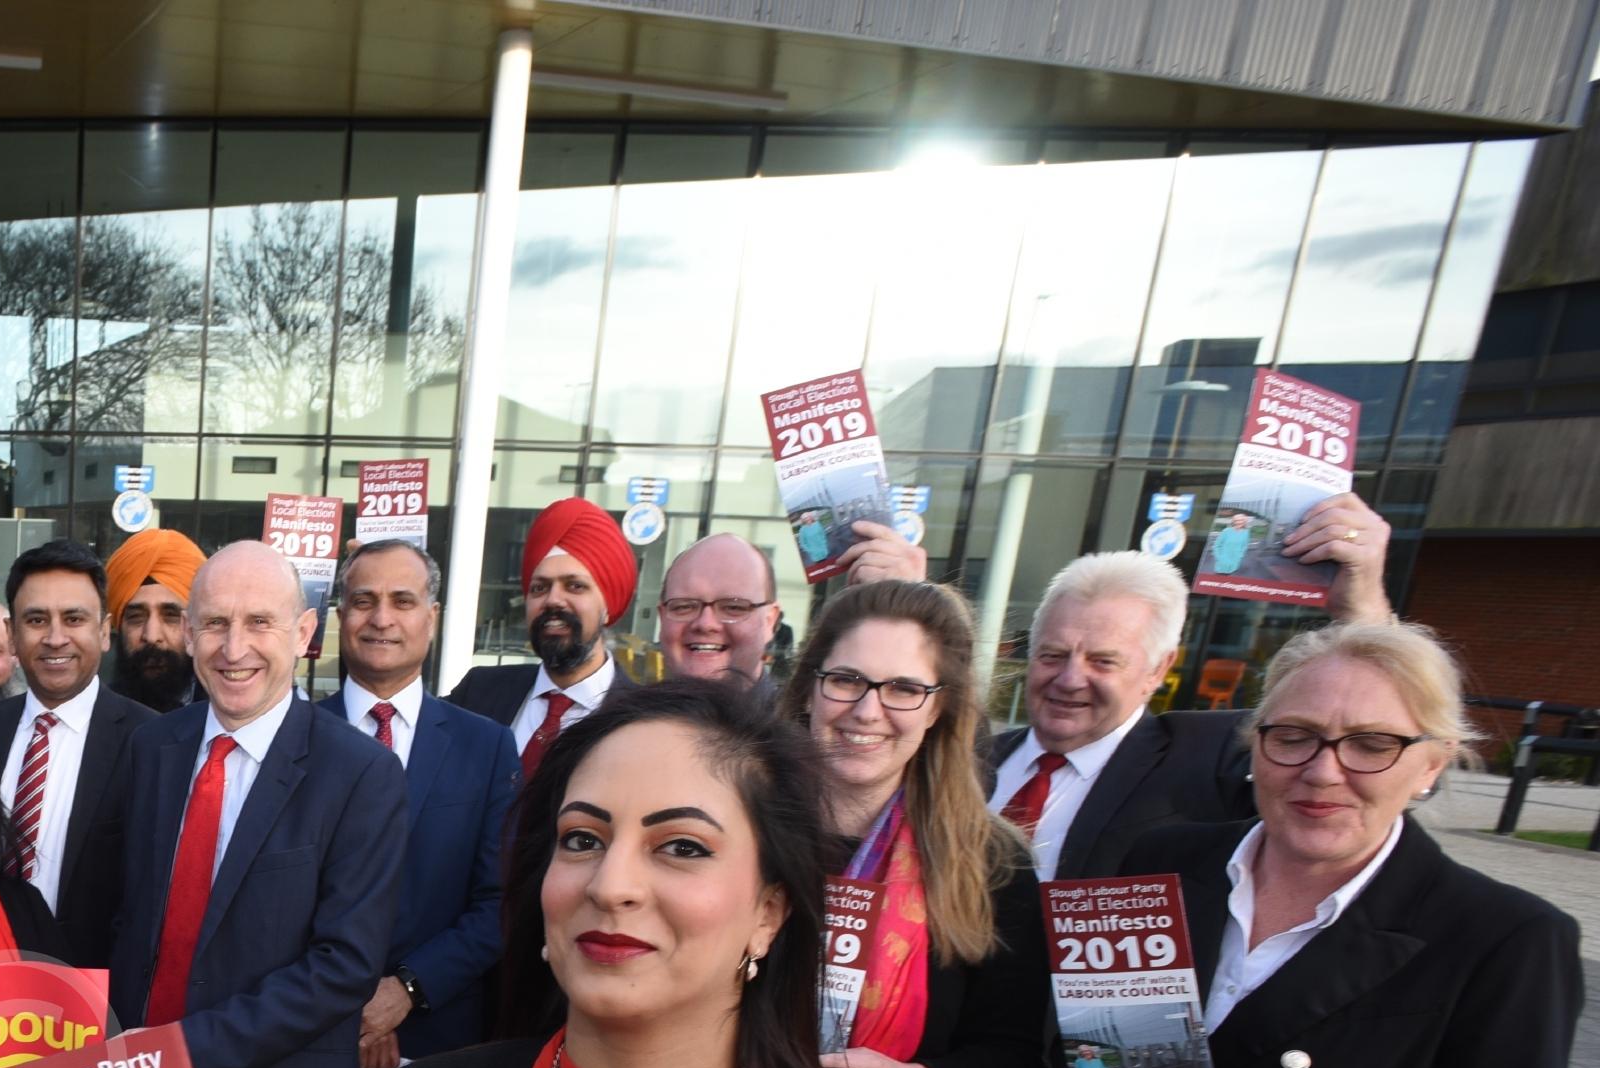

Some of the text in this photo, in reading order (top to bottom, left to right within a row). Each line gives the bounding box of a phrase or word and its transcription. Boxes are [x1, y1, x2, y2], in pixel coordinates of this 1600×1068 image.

[771, 383, 858, 414] Local Election
[774, 397, 861, 429] Manifesto
[1259, 399, 1350, 438] Manifesto
[777, 412, 867, 457] 2019
[1251, 416, 1348, 465] 2019
[363, 481, 423, 493] Manifesto
[362, 493, 422, 516] 2019
[270, 517, 335, 532] Manifesto
[269, 531, 333, 557] 2019
[846, 886, 876, 900] Party
[1049, 883, 1167, 899] Slough Labour Party
[824, 895, 871, 912] ection
[1050, 895, 1169, 913] Local Election
[1053, 913, 1173, 934] Manifesto
[1056, 934, 1177, 970] 2019
[1058, 984, 1190, 999] LABOUR COUNCIL
